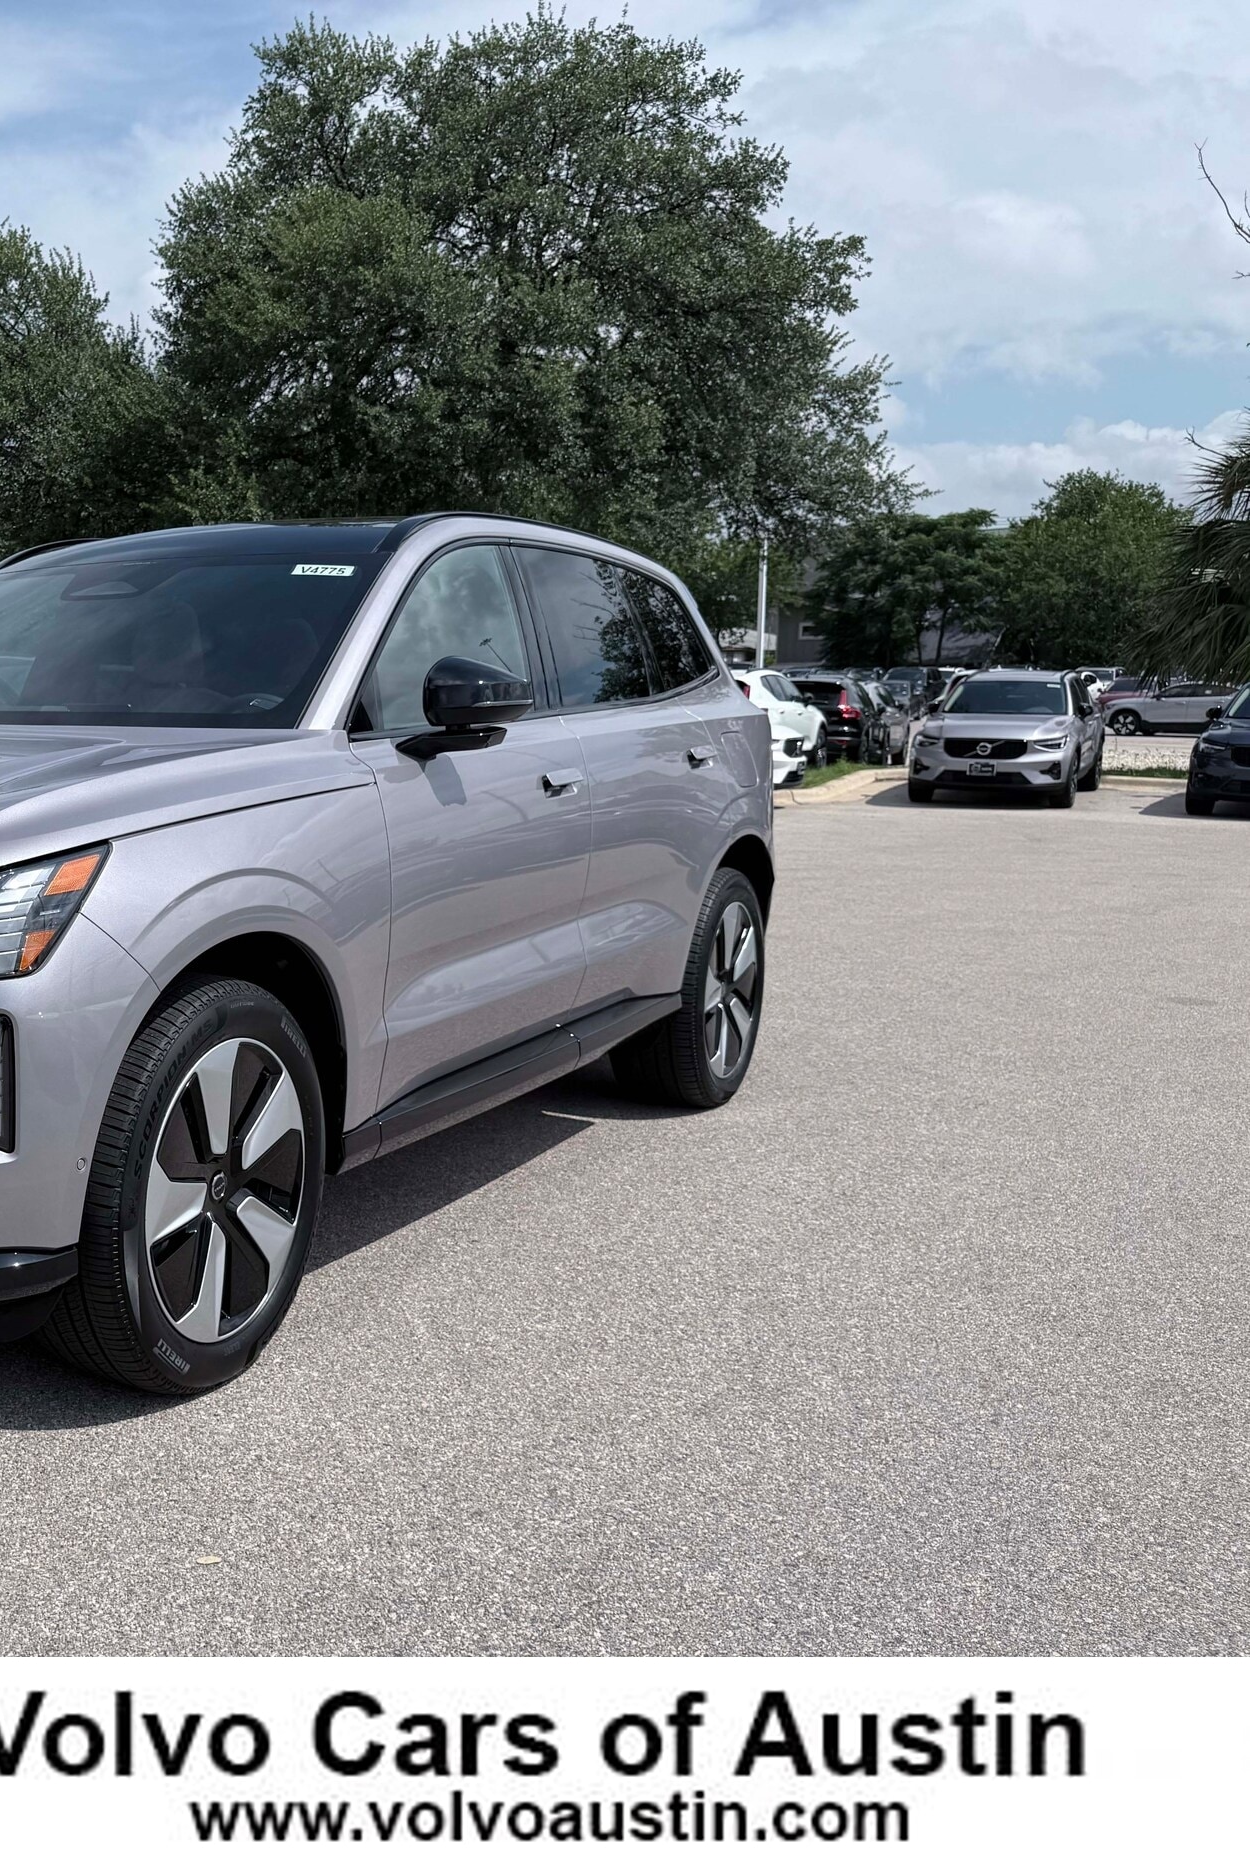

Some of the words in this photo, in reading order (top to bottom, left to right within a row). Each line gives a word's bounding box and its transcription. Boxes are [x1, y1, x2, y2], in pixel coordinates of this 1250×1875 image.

[300, 565, 347, 575] V4775
[133, 1045, 188, 1180] SCORPION
[152, 1338, 191, 1375] PIRELLI
